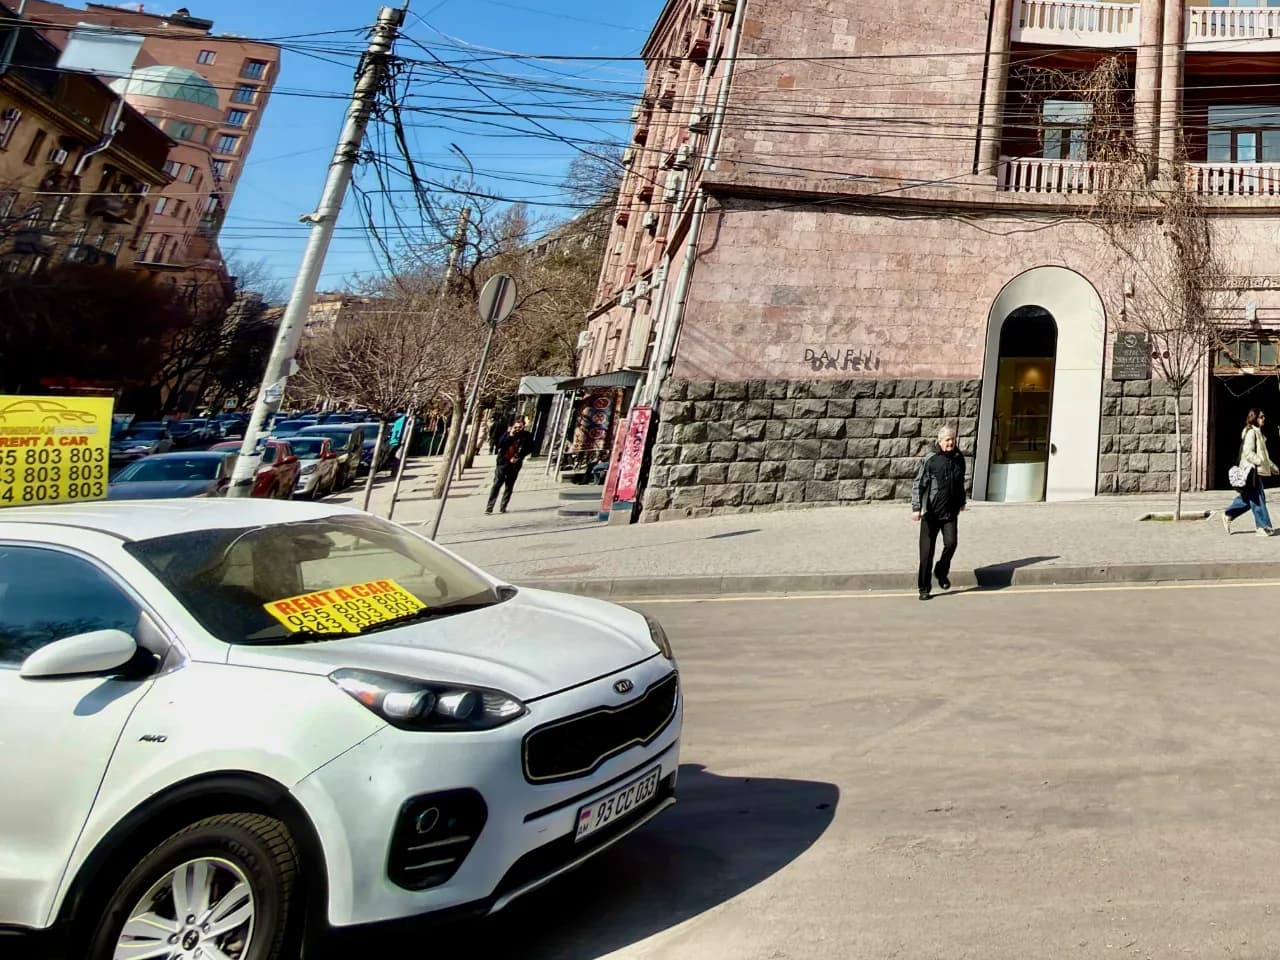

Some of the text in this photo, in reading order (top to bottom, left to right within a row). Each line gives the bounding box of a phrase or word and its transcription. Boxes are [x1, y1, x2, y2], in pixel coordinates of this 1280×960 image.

[804, 348, 874, 363] DAJELI
[0, 436, 88, 448] RENT A CAR
[0, 447, 104, 466] 5 803 803
[24, 466, 61, 483] 803
[69, 465, 104, 481] 803
[22, 484, 60, 502] 803
[68, 482, 103, 499] 803
[274, 581, 396, 615] RENT A CAR
[287, 591, 409, 626] 055 803 803
[344, 608, 383, 623] 803
[384, 600, 419, 614] 803
[595, 799, 615, 826] 93
[615, 788, 634, 815] CC
[635, 773, 656, 802] 033
